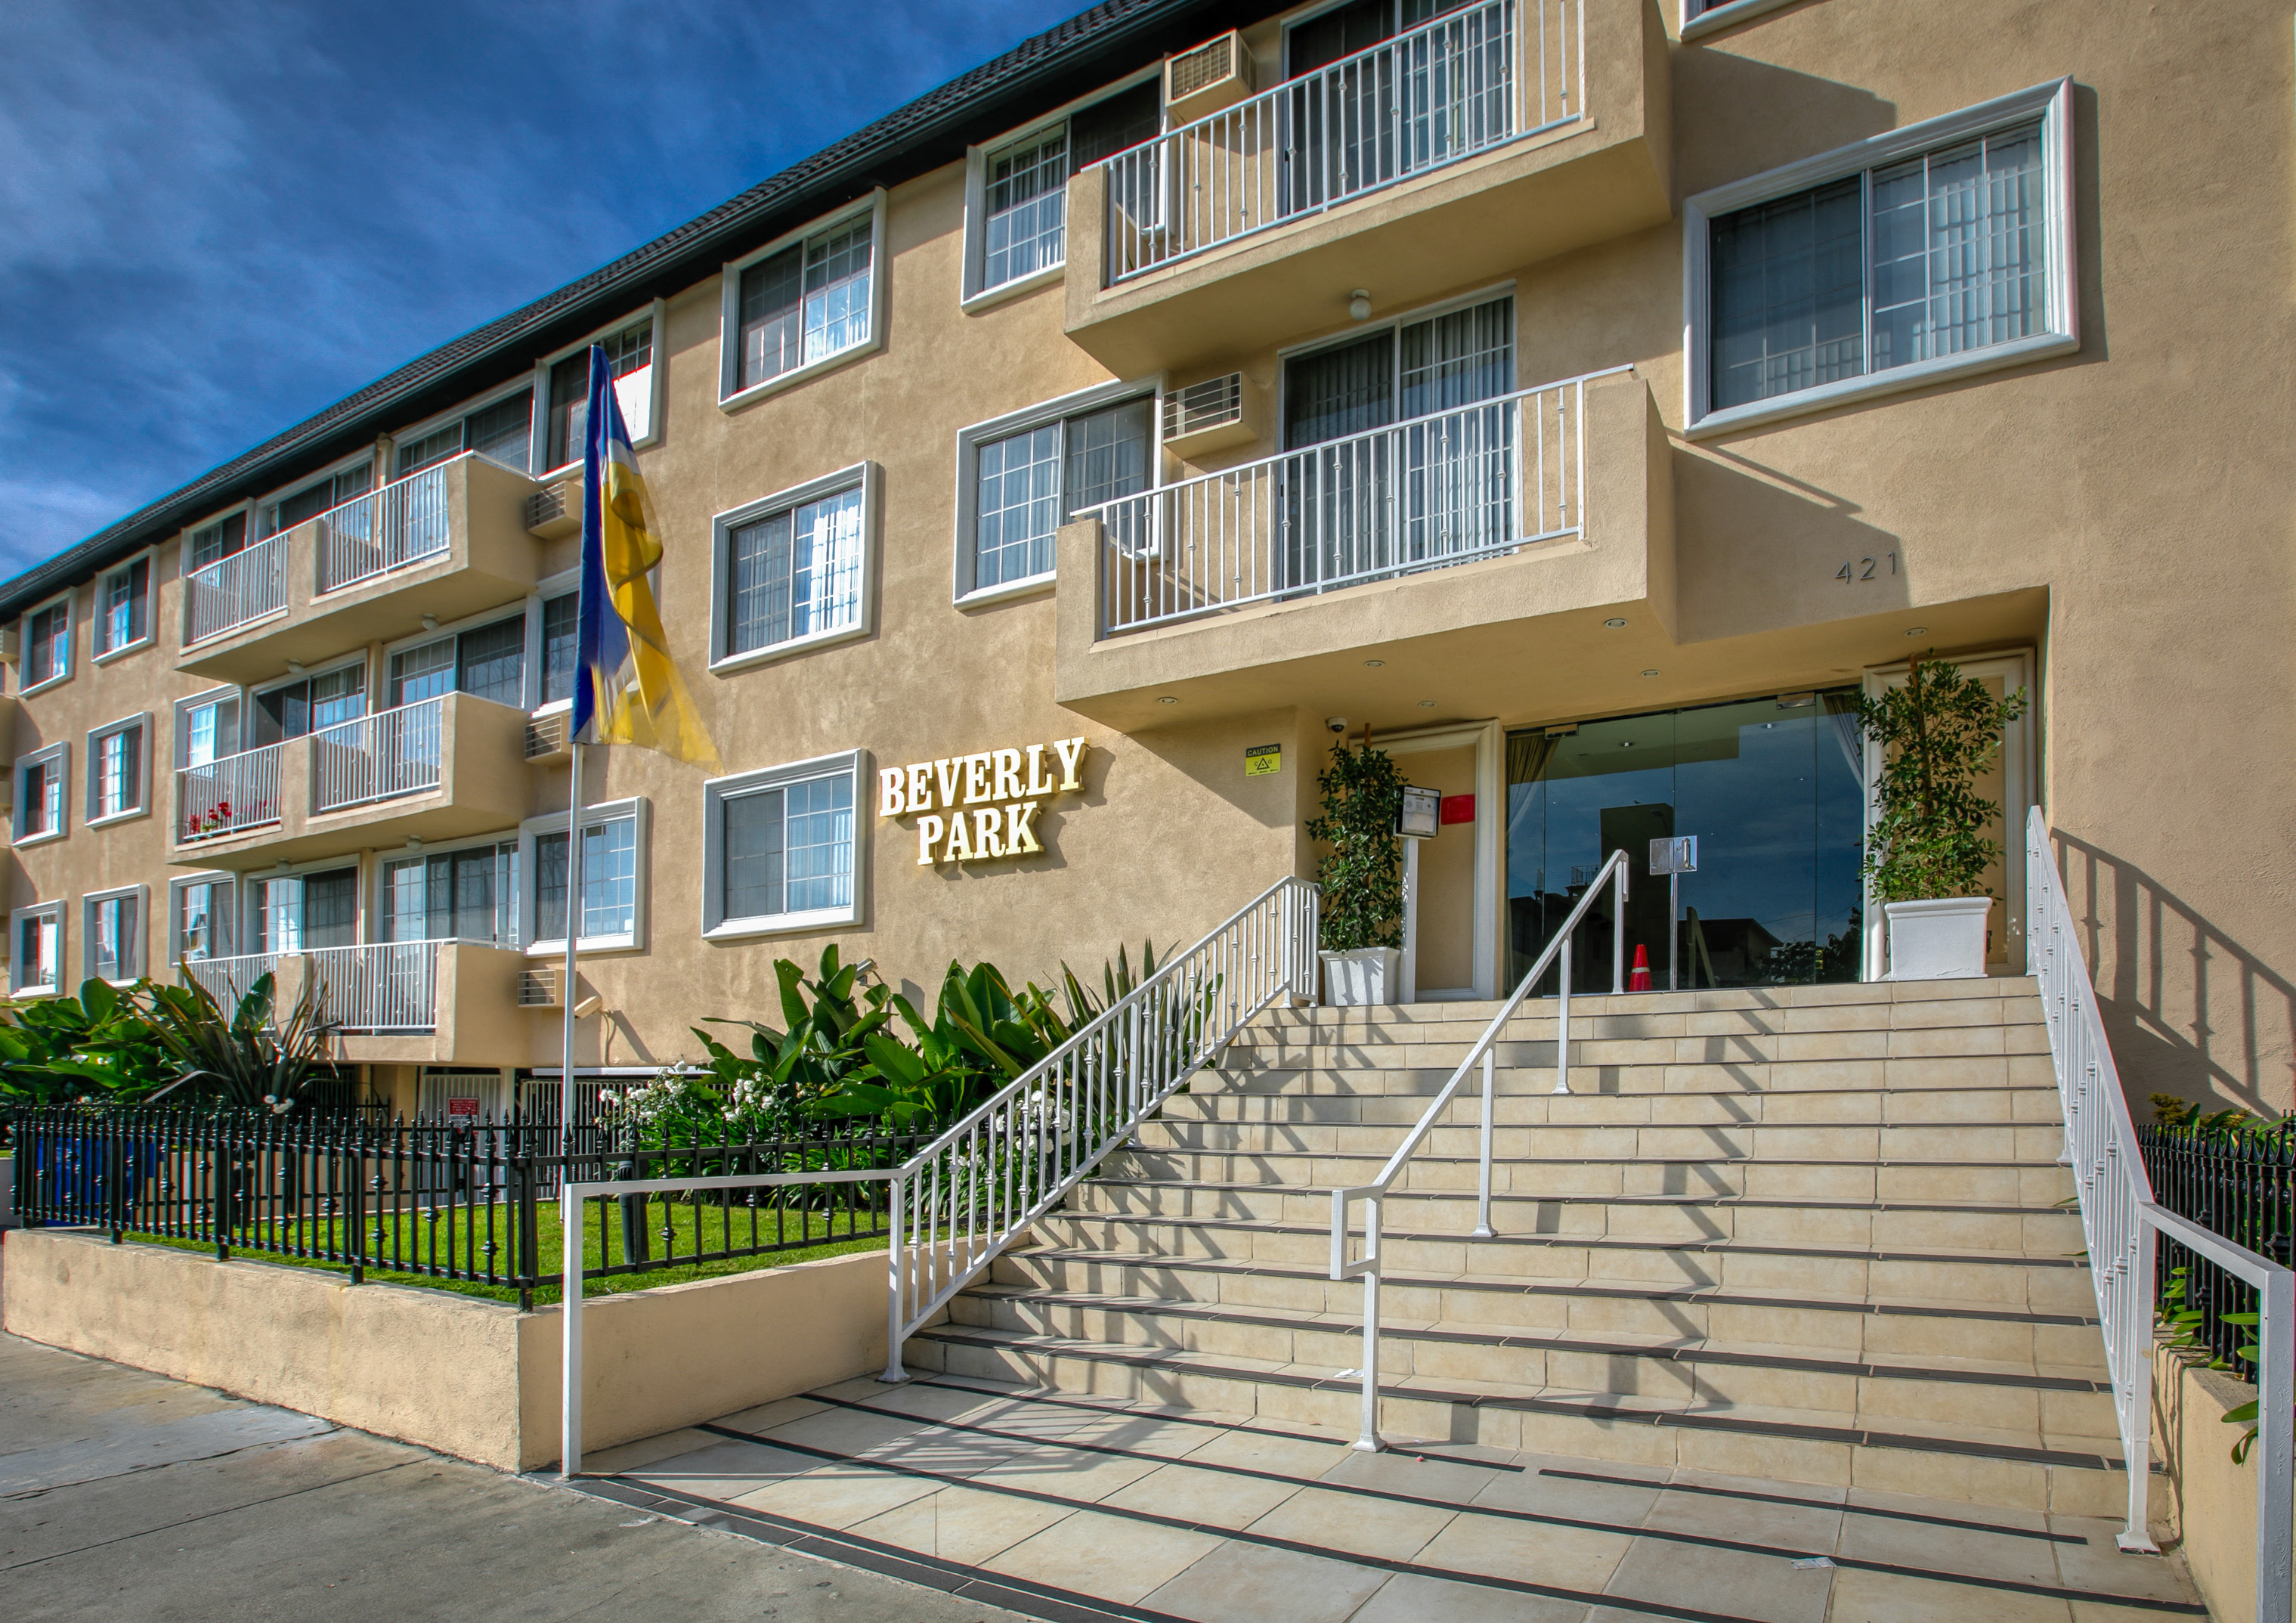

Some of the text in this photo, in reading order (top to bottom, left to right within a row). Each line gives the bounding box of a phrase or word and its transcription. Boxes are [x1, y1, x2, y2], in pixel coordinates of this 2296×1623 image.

[1835, 551, 1895, 584] 421
[1247, 746, 1279, 757] CAUTION
[879, 736, 1088, 817] BEVERLY
[916, 801, 1041, 866] PARK
